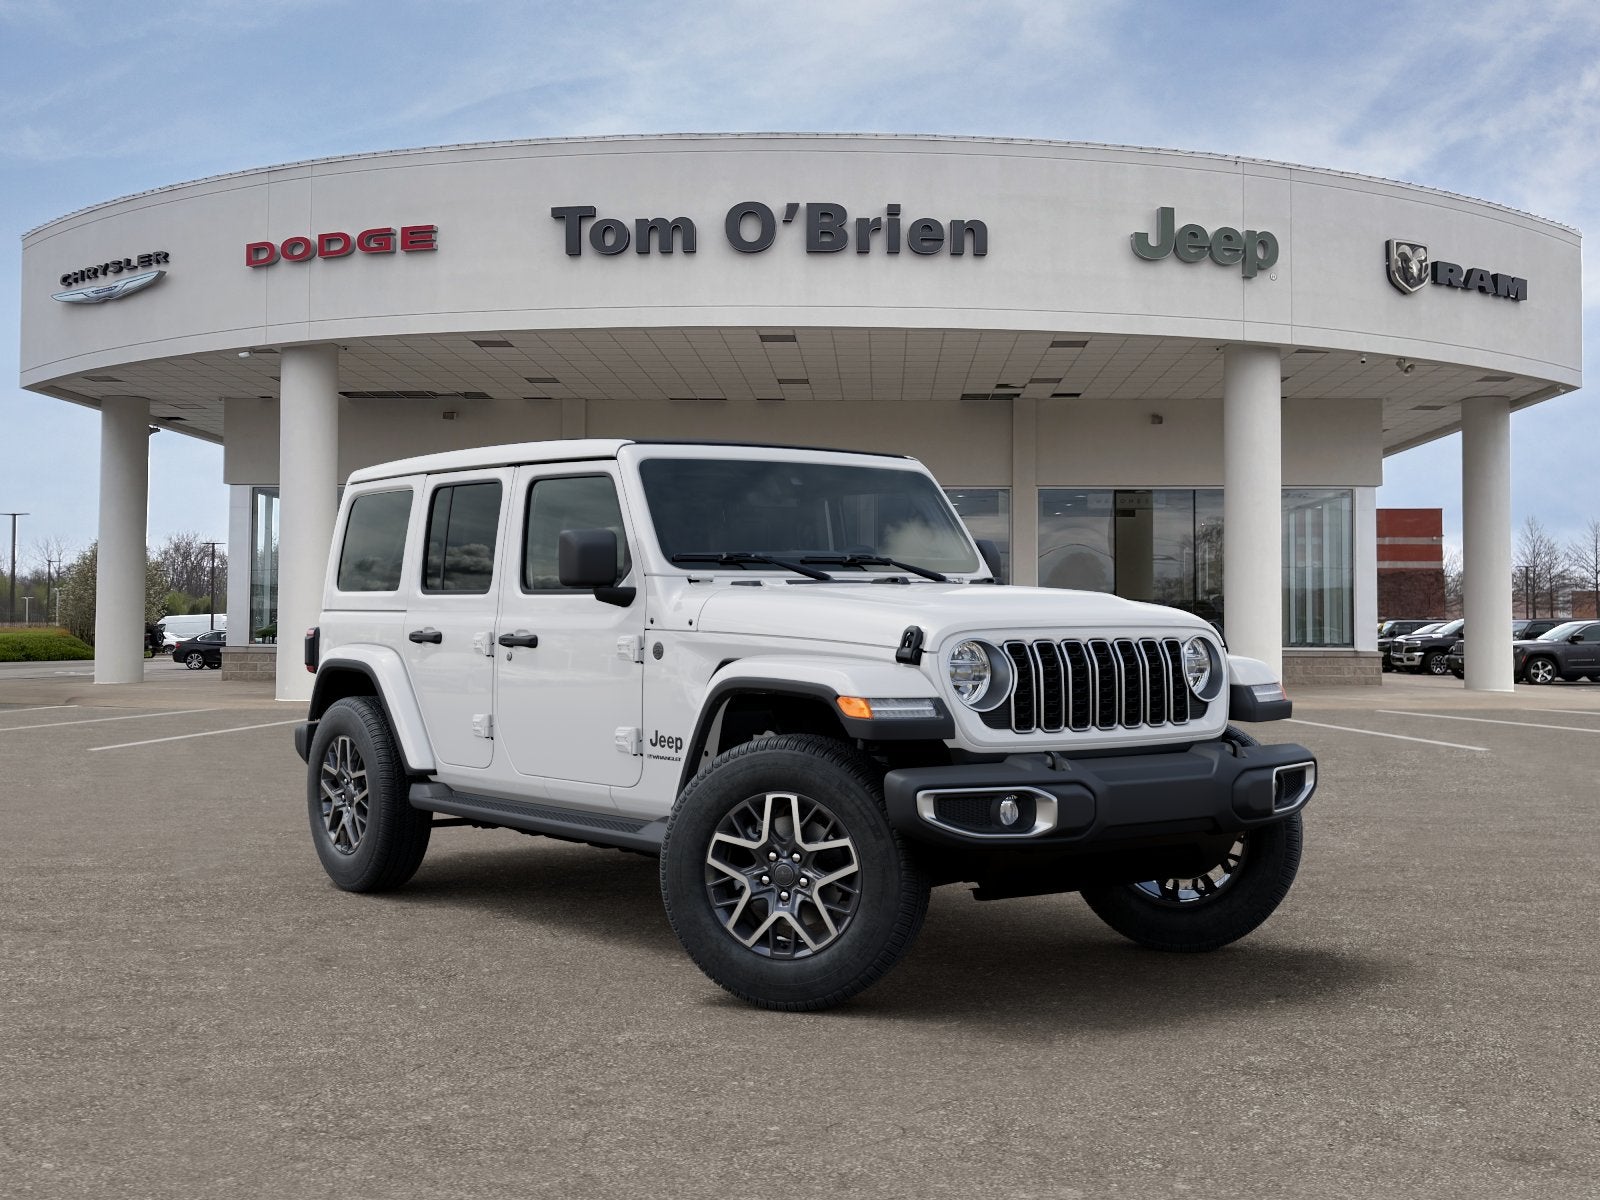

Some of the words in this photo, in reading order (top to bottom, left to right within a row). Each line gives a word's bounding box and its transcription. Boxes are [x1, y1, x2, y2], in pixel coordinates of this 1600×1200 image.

[246, 224, 438, 268] DODGE
[551, 205, 697, 256] Tom
[725, 201, 988, 256] O'Brien
[1130, 206, 1279, 278] Jeep
[60, 250, 170, 287] CHRYSLER
[1430, 260, 1528, 302] RAM
[649, 729, 682, 753] Jeep
